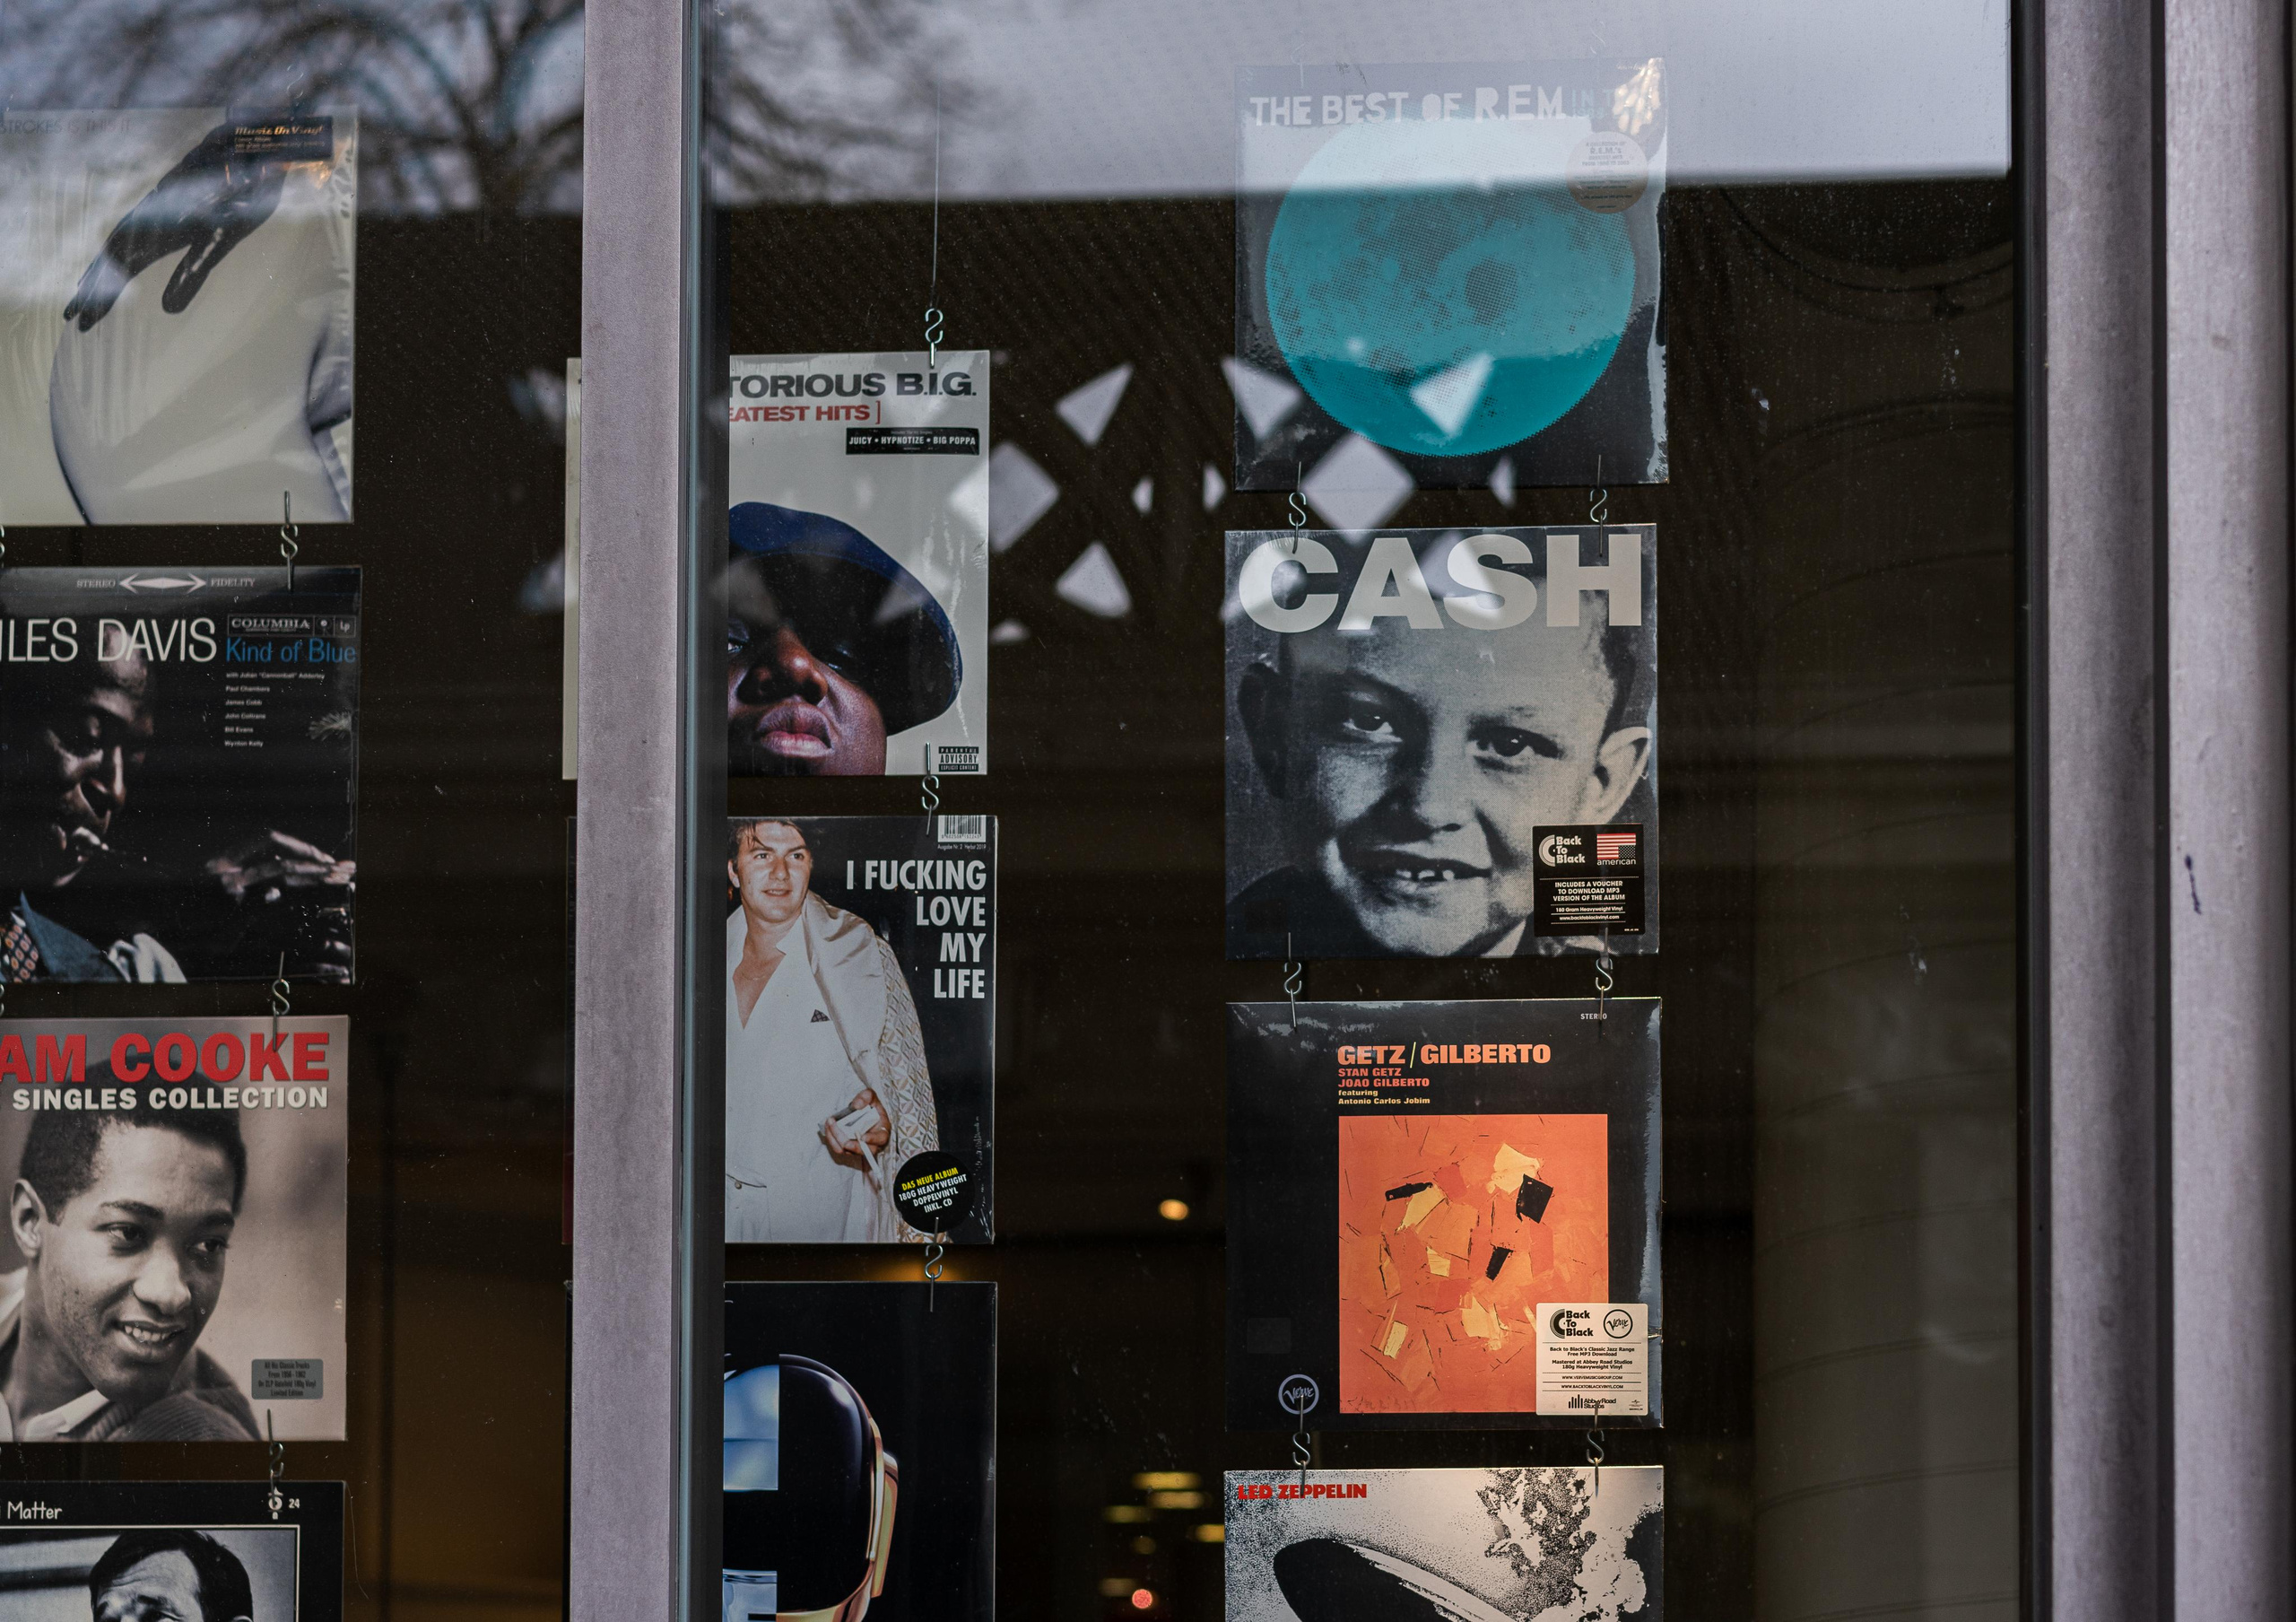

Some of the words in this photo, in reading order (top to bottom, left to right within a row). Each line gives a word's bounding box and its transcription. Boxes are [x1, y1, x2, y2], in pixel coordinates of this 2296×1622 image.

[1249, 95, 1311, 126] THE
[1322, 92, 1408, 125] BEST
[1422, 92, 1462, 122] OF
[729, 406, 810, 423] ATEST
[816, 405, 870, 422] HITS
[848, 436, 872, 445] JUICY
[881, 436, 925, 445] HYPNOTIZE
[933, 436, 947, 445] BIG
[949, 436, 976, 445] POPPA
[76, 579, 116, 589] STEREO
[211, 578, 255, 588] FIDELITY
[1239, 533, 1643, 634] CASH
[231, 618, 310, 629] COLUMBIA
[98, 617, 217, 662] DAVIS
[226, 637, 272, 662] Kind
[281, 641, 302, 662] of
[309, 637, 356, 662] Blue
[940, 754, 978, 763] ADVISORY
[1556, 835, 1582, 845] Back
[1556, 845, 1568, 855] To
[1556, 854, 1586, 864] Black
[847, 860, 854, 890] I
[865, 859, 986, 890] FUCKING
[917, 896, 986, 926] LOVE
[940, 933, 986, 963] MY
[934, 969, 985, 998] LIFE
[0, 1033, 86, 1084] AM
[110, 1033, 329, 1084] COOKE
[1338, 1068, 1369, 1077] STAN
[1372, 1068, 1402, 1077] GETZ
[1338, 1078, 1370, 1087] JOAO
[1373, 1077, 1430, 1087] GILBERTO
[13, 1088, 137, 1111] SINGLES
[149, 1087, 328, 1111] COLLECTION
[1338, 1089, 1378, 1097] featuring
[901, 1180, 916, 1190] DAS
[916, 1174, 934, 1186] NEUE
[935, 1167, 959, 1181] ALBUM
[899, 1190, 917, 1201] 180G
[917, 1173, 968, 1196] HEAVYWEIGHT
[913, 1187, 959, 1207] DOPPELVINYL
[924, 1203, 943, 1213] INKL.
[943, 1198, 952, 1207] CD
[1566, 1310, 1590, 1319] Back
[1566, 1319, 1577, 1327] To
[1566, 1328, 1594, 1336] Black
[1238, 1484, 1273, 1499] LED
[1278, 1484, 1367, 1499] ZEPPELIN
[7, 1501, 63, 1521] Matter
[289, 1498, 300, 1509] 24
